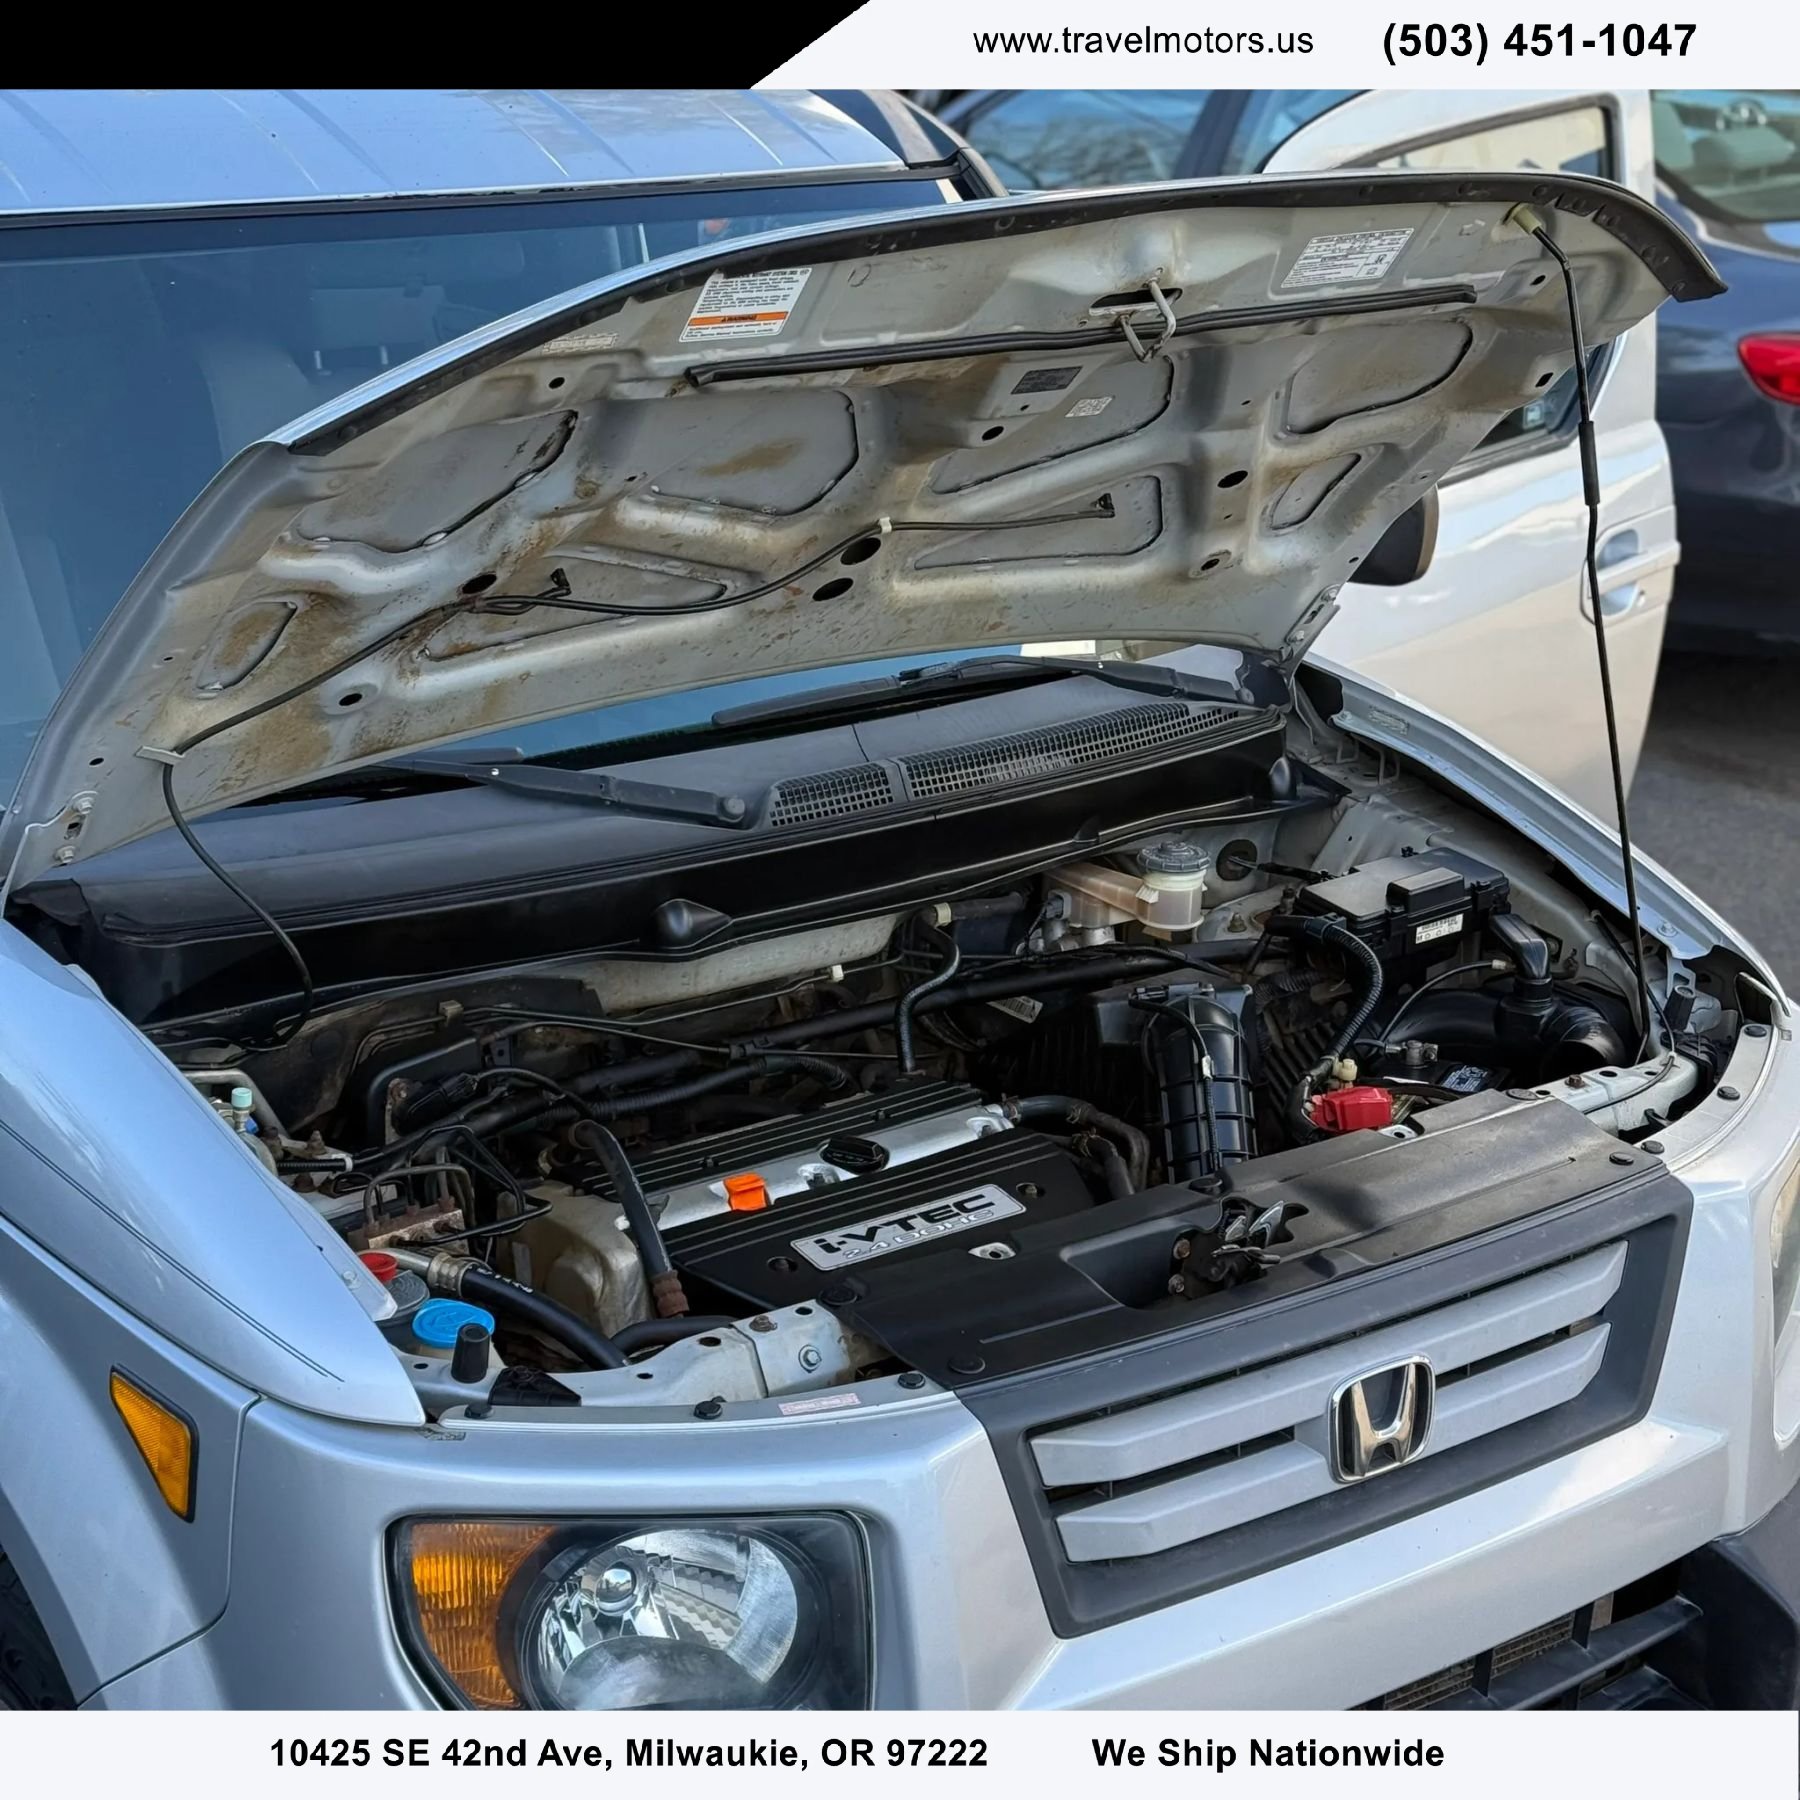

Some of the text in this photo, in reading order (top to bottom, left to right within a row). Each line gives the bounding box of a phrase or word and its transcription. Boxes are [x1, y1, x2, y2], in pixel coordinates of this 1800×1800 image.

[813, 1194, 995, 1254] i-VTEC
[842, 1208, 995, 1259] 2.4 DOHC
